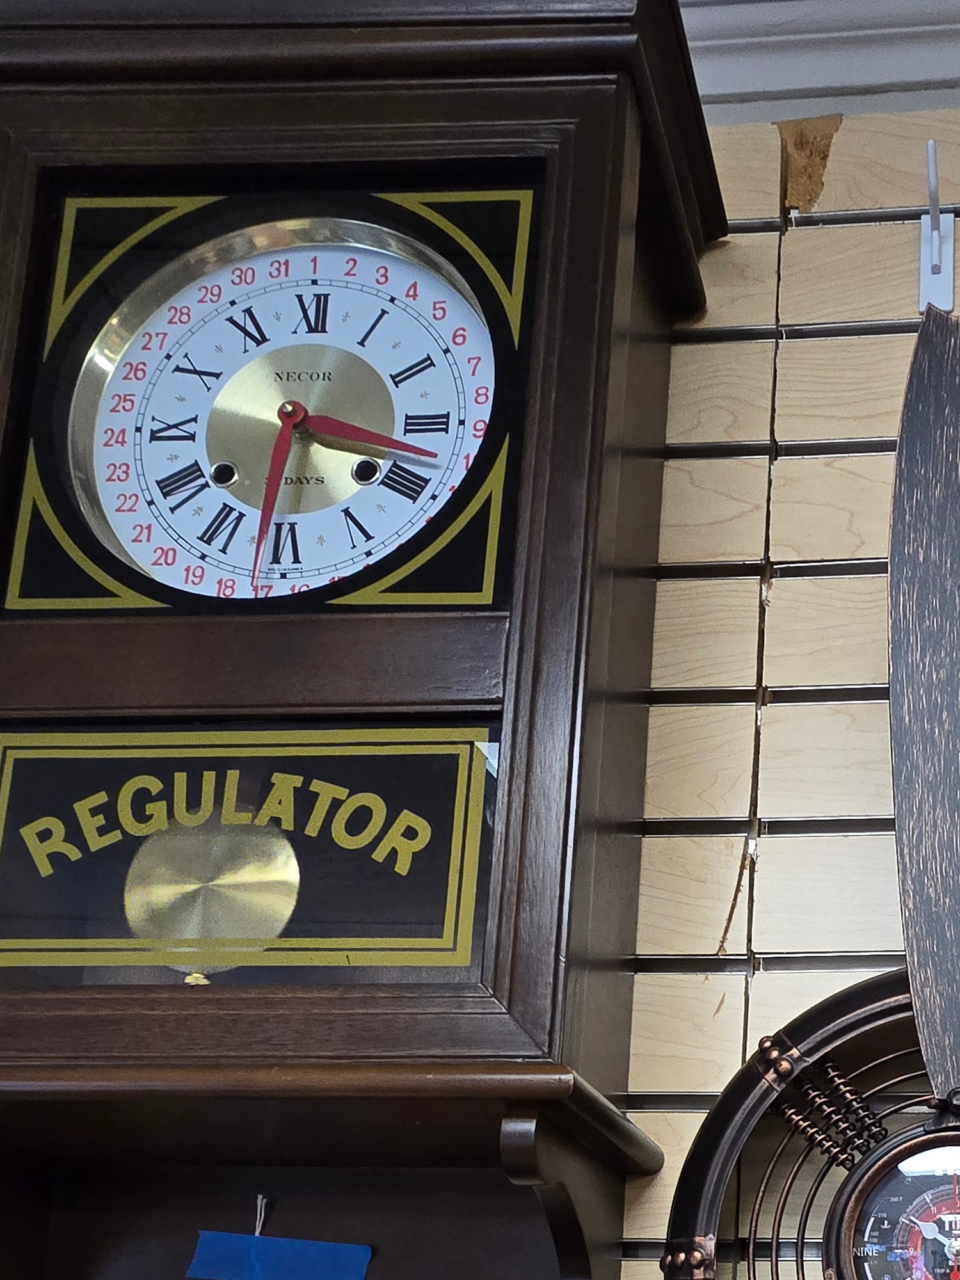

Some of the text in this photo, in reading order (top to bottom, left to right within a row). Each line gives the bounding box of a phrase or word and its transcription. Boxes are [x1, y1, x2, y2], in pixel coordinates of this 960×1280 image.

[269, 259, 290, 279] 31
[310, 256, 318, 275] 1
[344, 258, 358, 277] 2
[375, 265, 389, 285] 3
[231, 267, 256, 286] 30
[197, 285, 222, 304] 29
[405, 281, 419, 301] 4
[167, 306, 191, 325] 28
[291, 293, 331, 334] XII
[432, 300, 447, 321] 5
[224, 305, 270, 354] XI
[356, 308, 389, 348] I
[451, 327, 467, 346] 6
[141, 332, 168, 351] 27
[122, 361, 147, 381] 26
[171, 352, 224, 392] X
[274, 371, 332, 382] NECOR
[389, 353, 436, 389] II
[467, 356, 482, 377] 7
[109, 393, 136, 413] 25
[474, 386, 489, 405] 8
[149, 414, 199, 444] IX
[403, 411, 450, 436] III
[472, 419, 488, 439] 9
[103, 428, 127, 447] 24
[105, 463, 131, 482] 23
[463, 453, 477, 472] 1
[155, 459, 211, 515] VIII
[283, 476, 325, 486] DAYS
[115, 493, 140, 513] 22
[131, 524, 153, 543] 21
[196, 502, 247, 555] VII
[341, 506, 375, 550] V
[269, 522, 302, 564] VI
[151, 547, 177, 566] 20
[184, 565, 205, 586] 19
[216, 578, 236, 598] 18
[252, 585, 273, 598] 17
[19, 770, 432, 878] REGULATOR
[853, 1247, 879, 1256] NINE
